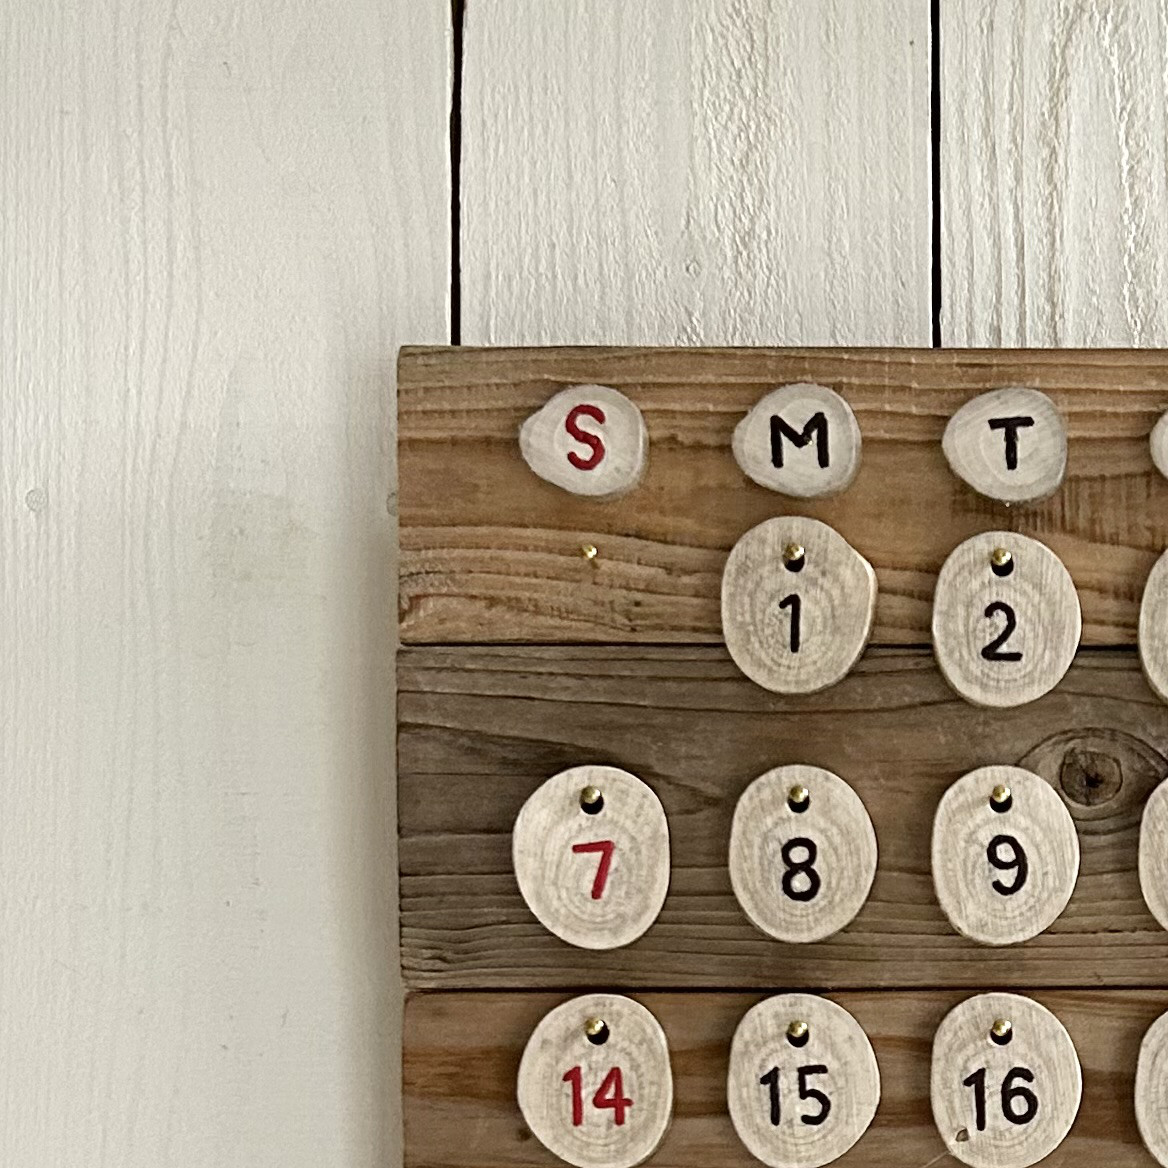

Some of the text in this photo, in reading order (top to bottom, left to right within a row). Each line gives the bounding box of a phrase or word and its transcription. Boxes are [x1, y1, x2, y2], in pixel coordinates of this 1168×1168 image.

[565, 405, 605, 470] S
[770, 412, 829, 468] M
[988, 417, 1034, 470] T
[779, 594, 800, 653] 1
[981, 601, 1022, 662] 2
[572, 841, 615, 899] 7
[781, 838, 820, 902] 8
[987, 835, 1028, 896] 9
[562, 1066, 633, 1126] 14
[760, 1065, 831, 1126] 15
[963, 1067, 1038, 1131] 16
